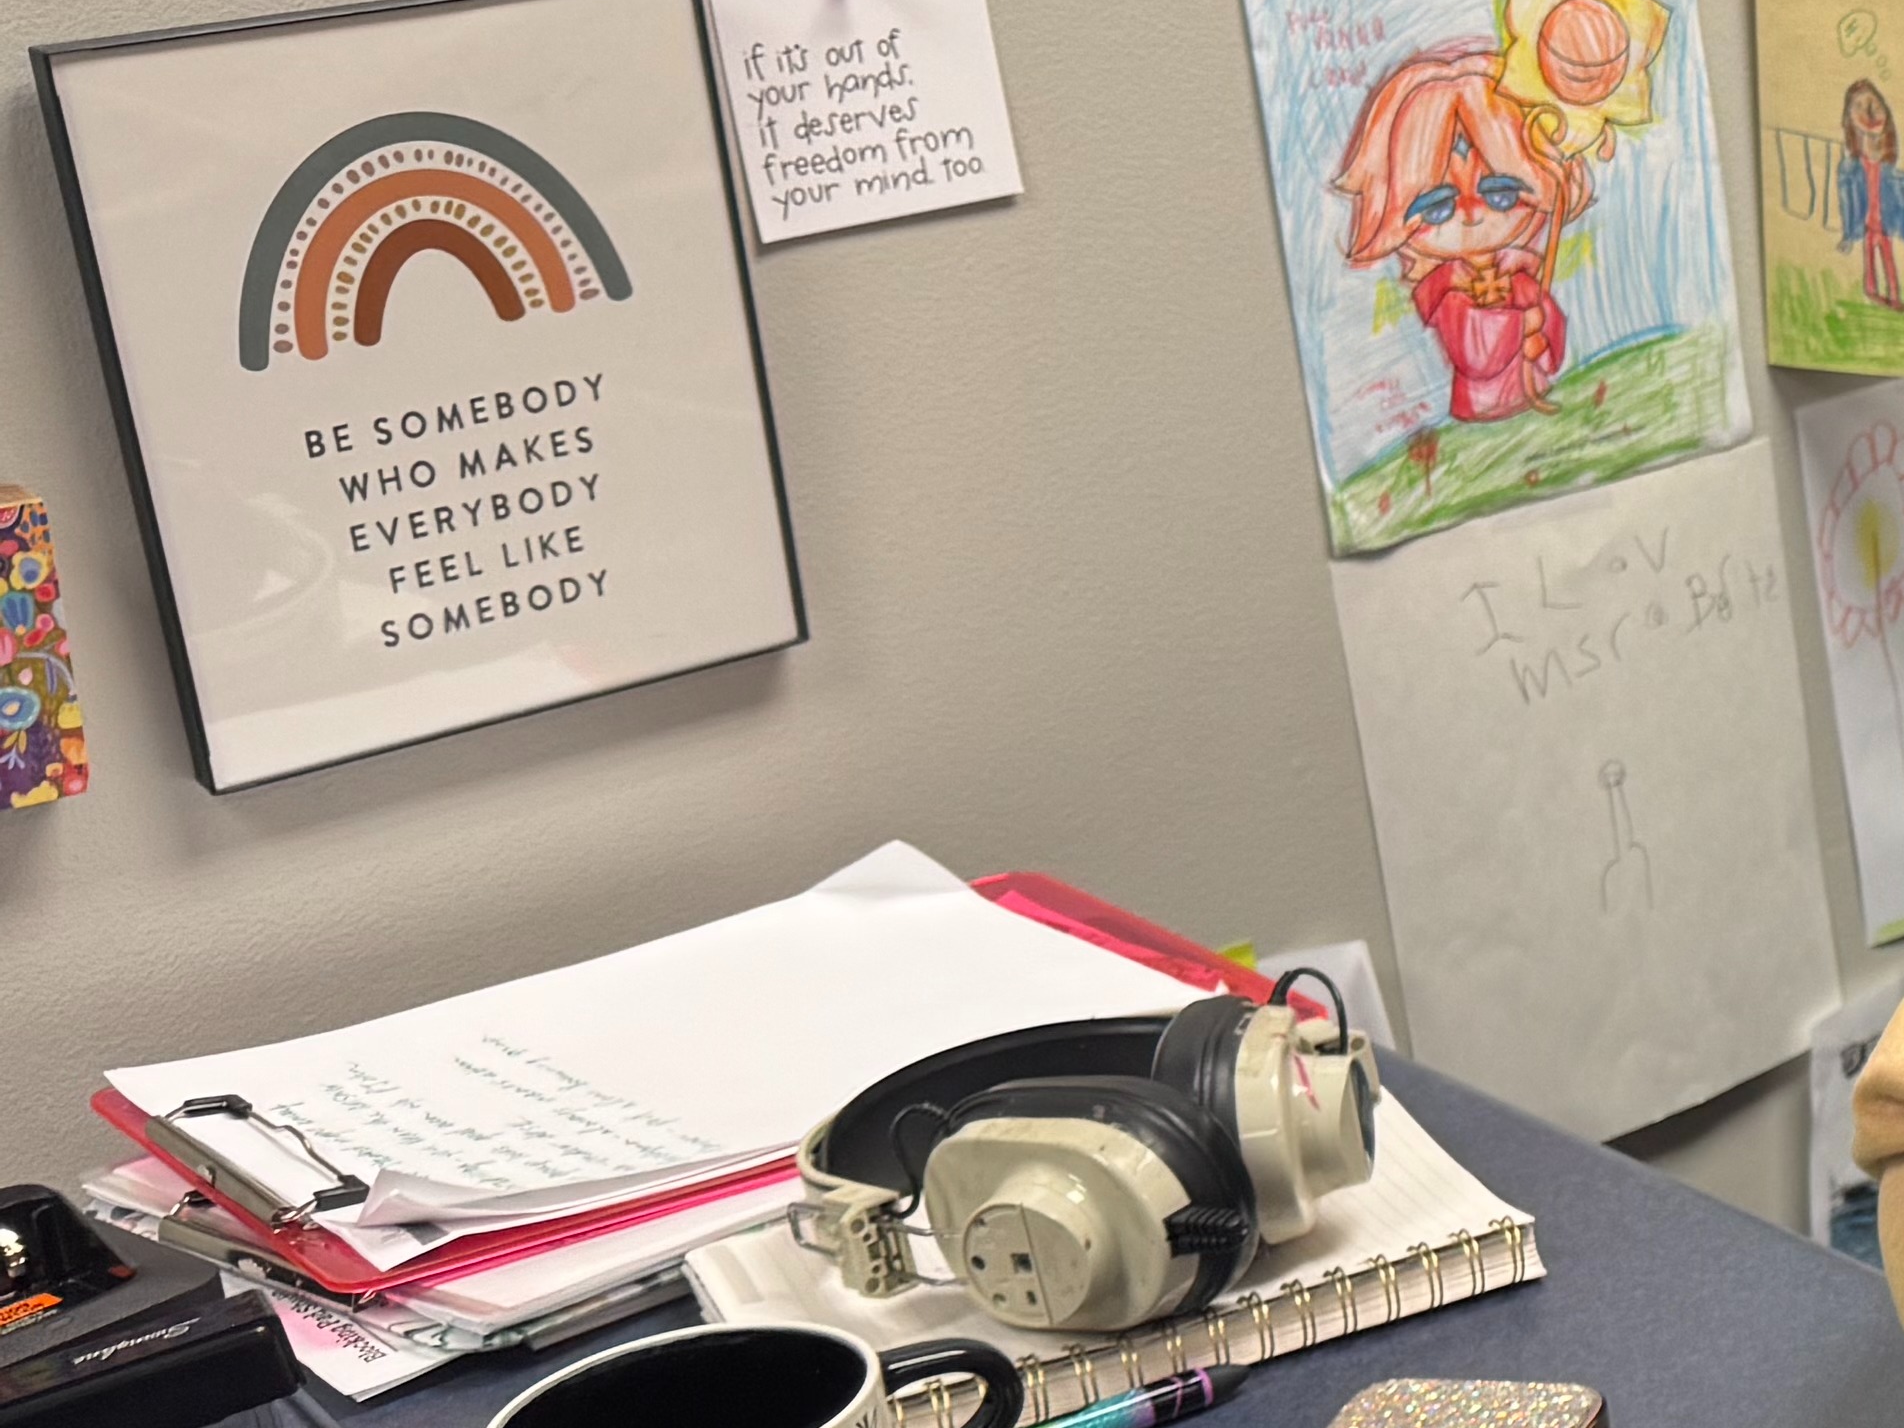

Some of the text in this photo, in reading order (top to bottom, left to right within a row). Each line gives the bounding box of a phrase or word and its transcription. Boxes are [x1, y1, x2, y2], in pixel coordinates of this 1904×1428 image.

[744, 42, 765, 82] if
[825, 38, 864, 67] out
[877, 28, 900, 60] of
[747, 81, 811, 122] your
[758, 96, 918, 151] it deserves
[763, 126, 974, 186] freedom from
[772, 156, 984, 222] your mind too
[304, 373, 603, 459] BE SOMEBODY
[339, 426, 594, 504] WHO MAKES
[349, 473, 600, 552] EVERYBODY
[389, 525, 585, 594] FEEL LIKE
[380, 568, 608, 648] SOMEBODY
[330, 1320, 387, 1363] Blocking
